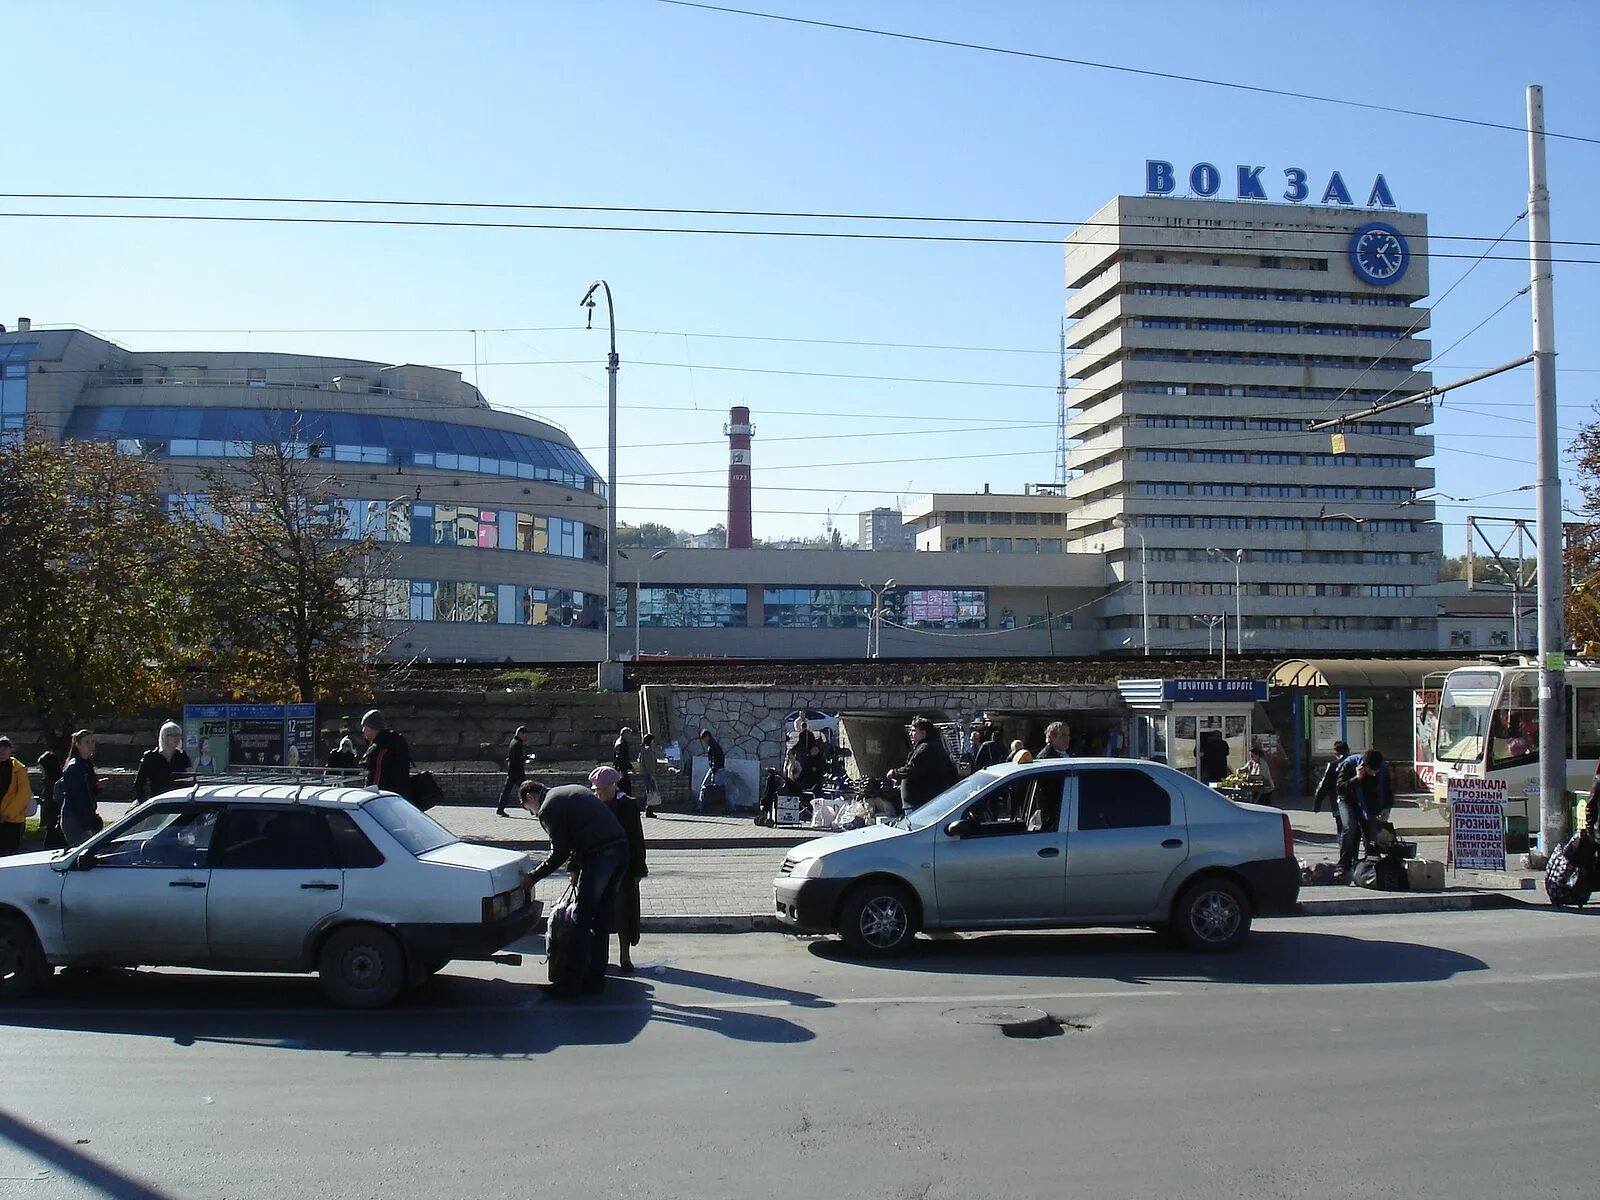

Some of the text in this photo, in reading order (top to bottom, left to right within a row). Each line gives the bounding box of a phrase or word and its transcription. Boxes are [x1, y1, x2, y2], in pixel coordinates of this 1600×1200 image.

[1145, 159, 1397, 208] ВОКЗАЛ
[1177, 681, 1214, 691] ПОЧИТАТЬ
[1226, 681, 1254, 691] ДОРОГЕ
[1448, 778, 1507, 790] МАХАЧКАЛА
[1457, 789, 1503, 800] ГРОЗНЫЙ
[1455, 803, 1500, 815] МАХАЧКАЛА
[1455, 818, 1500, 830] ГРОЗНЫЙ
[1455, 833, 1502, 842] МИНВОДЫ
[1456, 841, 1502, 849] ПЯТИГОРСК
